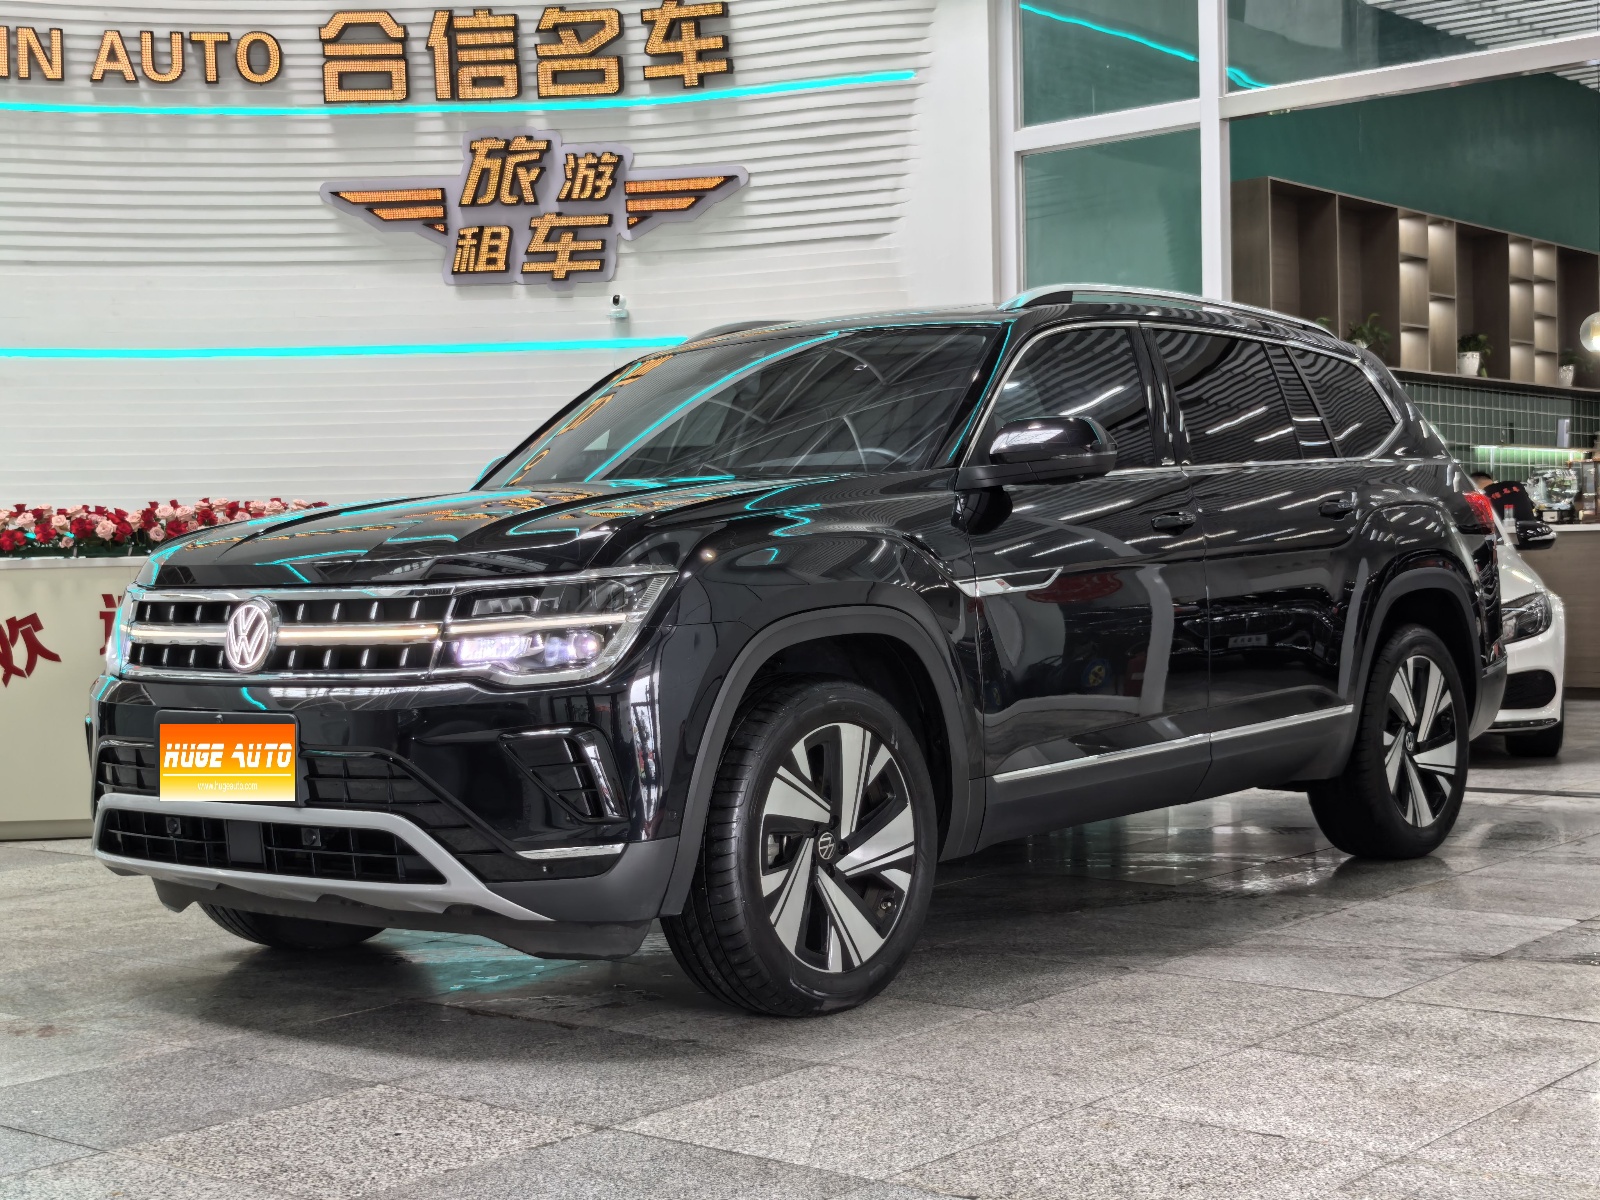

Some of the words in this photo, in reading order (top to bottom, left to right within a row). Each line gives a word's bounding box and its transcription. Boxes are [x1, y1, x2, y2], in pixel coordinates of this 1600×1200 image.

[90, 30, 282, 83] AUTO
[319, 0, 734, 103] 合信名车
[459, 136, 624, 207] 旅游
[451, 212, 613, 281] 租车
